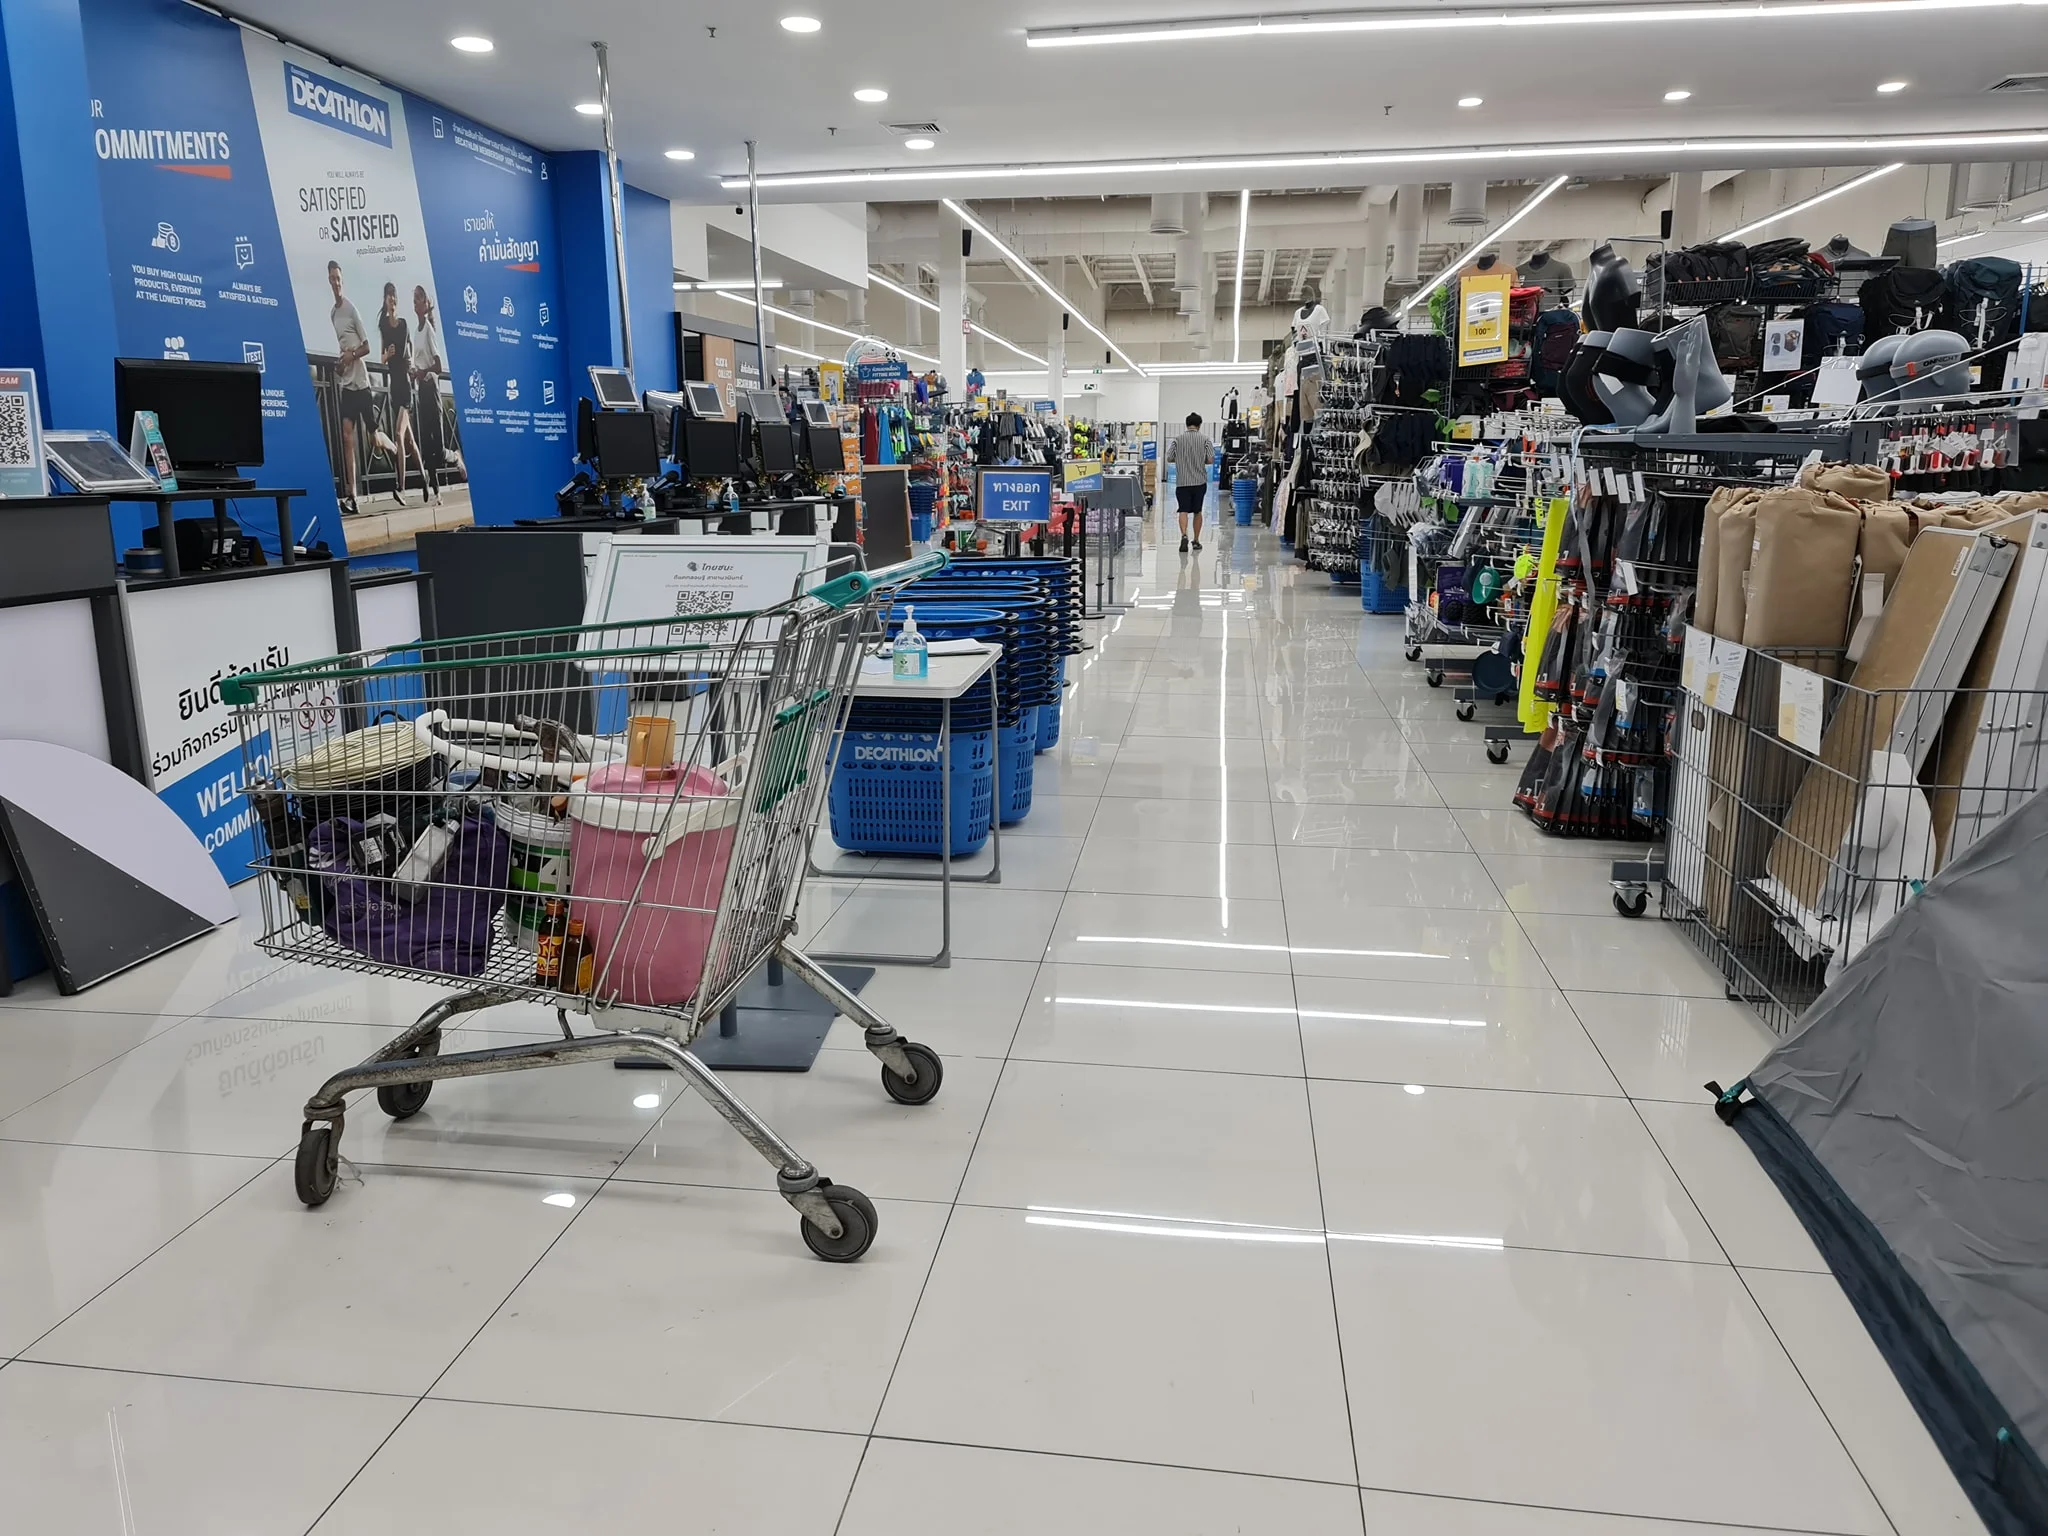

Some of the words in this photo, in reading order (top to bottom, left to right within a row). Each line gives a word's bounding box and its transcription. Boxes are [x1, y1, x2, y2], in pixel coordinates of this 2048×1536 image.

[291, 75, 387, 137] DECATHLON
[95, 128, 230, 160] OMMITMENTS
[299, 186, 367, 212] SATISFIED
[319, 227, 329, 240] OR
[330, 214, 399, 243] SATISFIED
[463, 209, 495, 232] เราขอให้
[479, 231, 539, 263] คำมั่นสัญญา
[131, 264, 146, 275] YOU
[146, 267, 160, 277] BUY
[160, 269, 176, 279] HIGH
[177, 272, 203, 284] QUALITY
[134, 277, 171, 292] PRODUCTS,
[171, 284, 202, 295] EVERYDAY
[232, 281, 254, 292] ALWAYS
[254, 285, 262, 294] BE
[136, 290, 144, 299] AT
[145, 292, 158, 302] THE
[159, 294, 184, 305] LOWEST
[184, 298, 207, 308] PRICES
[252, 295, 279, 307] SATISFIED
[246, 350, 261, 363] TEST
[0, 376, 19, 385] EAM
[265, 389, 285, 398] UNIQUE
[276, 409, 286, 418] BUY
[992, 482, 1040, 493] ทางออก
[1002, 500, 1031, 512] EXIT
[854, 746, 940, 763] DECATHLON
